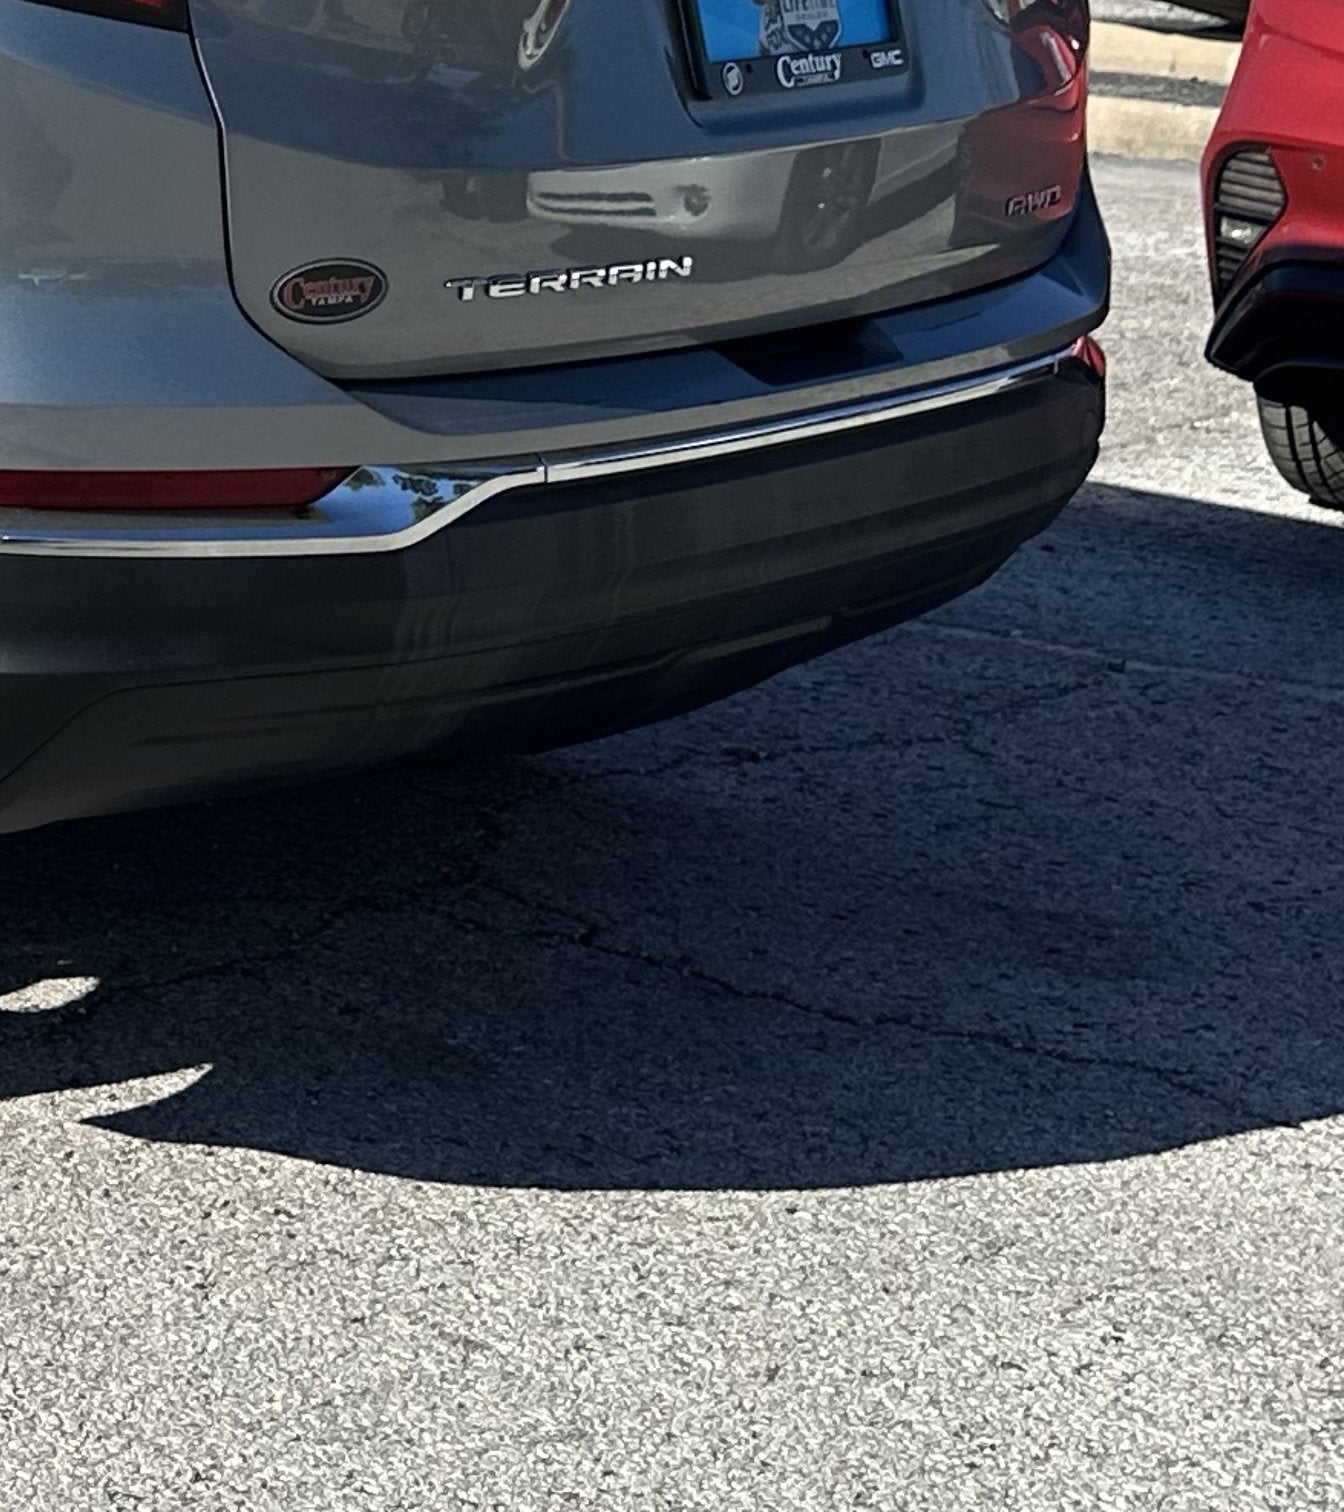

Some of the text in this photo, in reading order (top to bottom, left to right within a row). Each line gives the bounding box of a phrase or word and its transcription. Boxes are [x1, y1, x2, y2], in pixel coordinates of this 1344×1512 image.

[776, 52, 842, 88] Century
[870, 49, 904, 69] GMC
[1005, 184, 1061, 217] AWD
[283, 276, 376, 310] Century
[444, 255, 693, 302] TERRAIN
